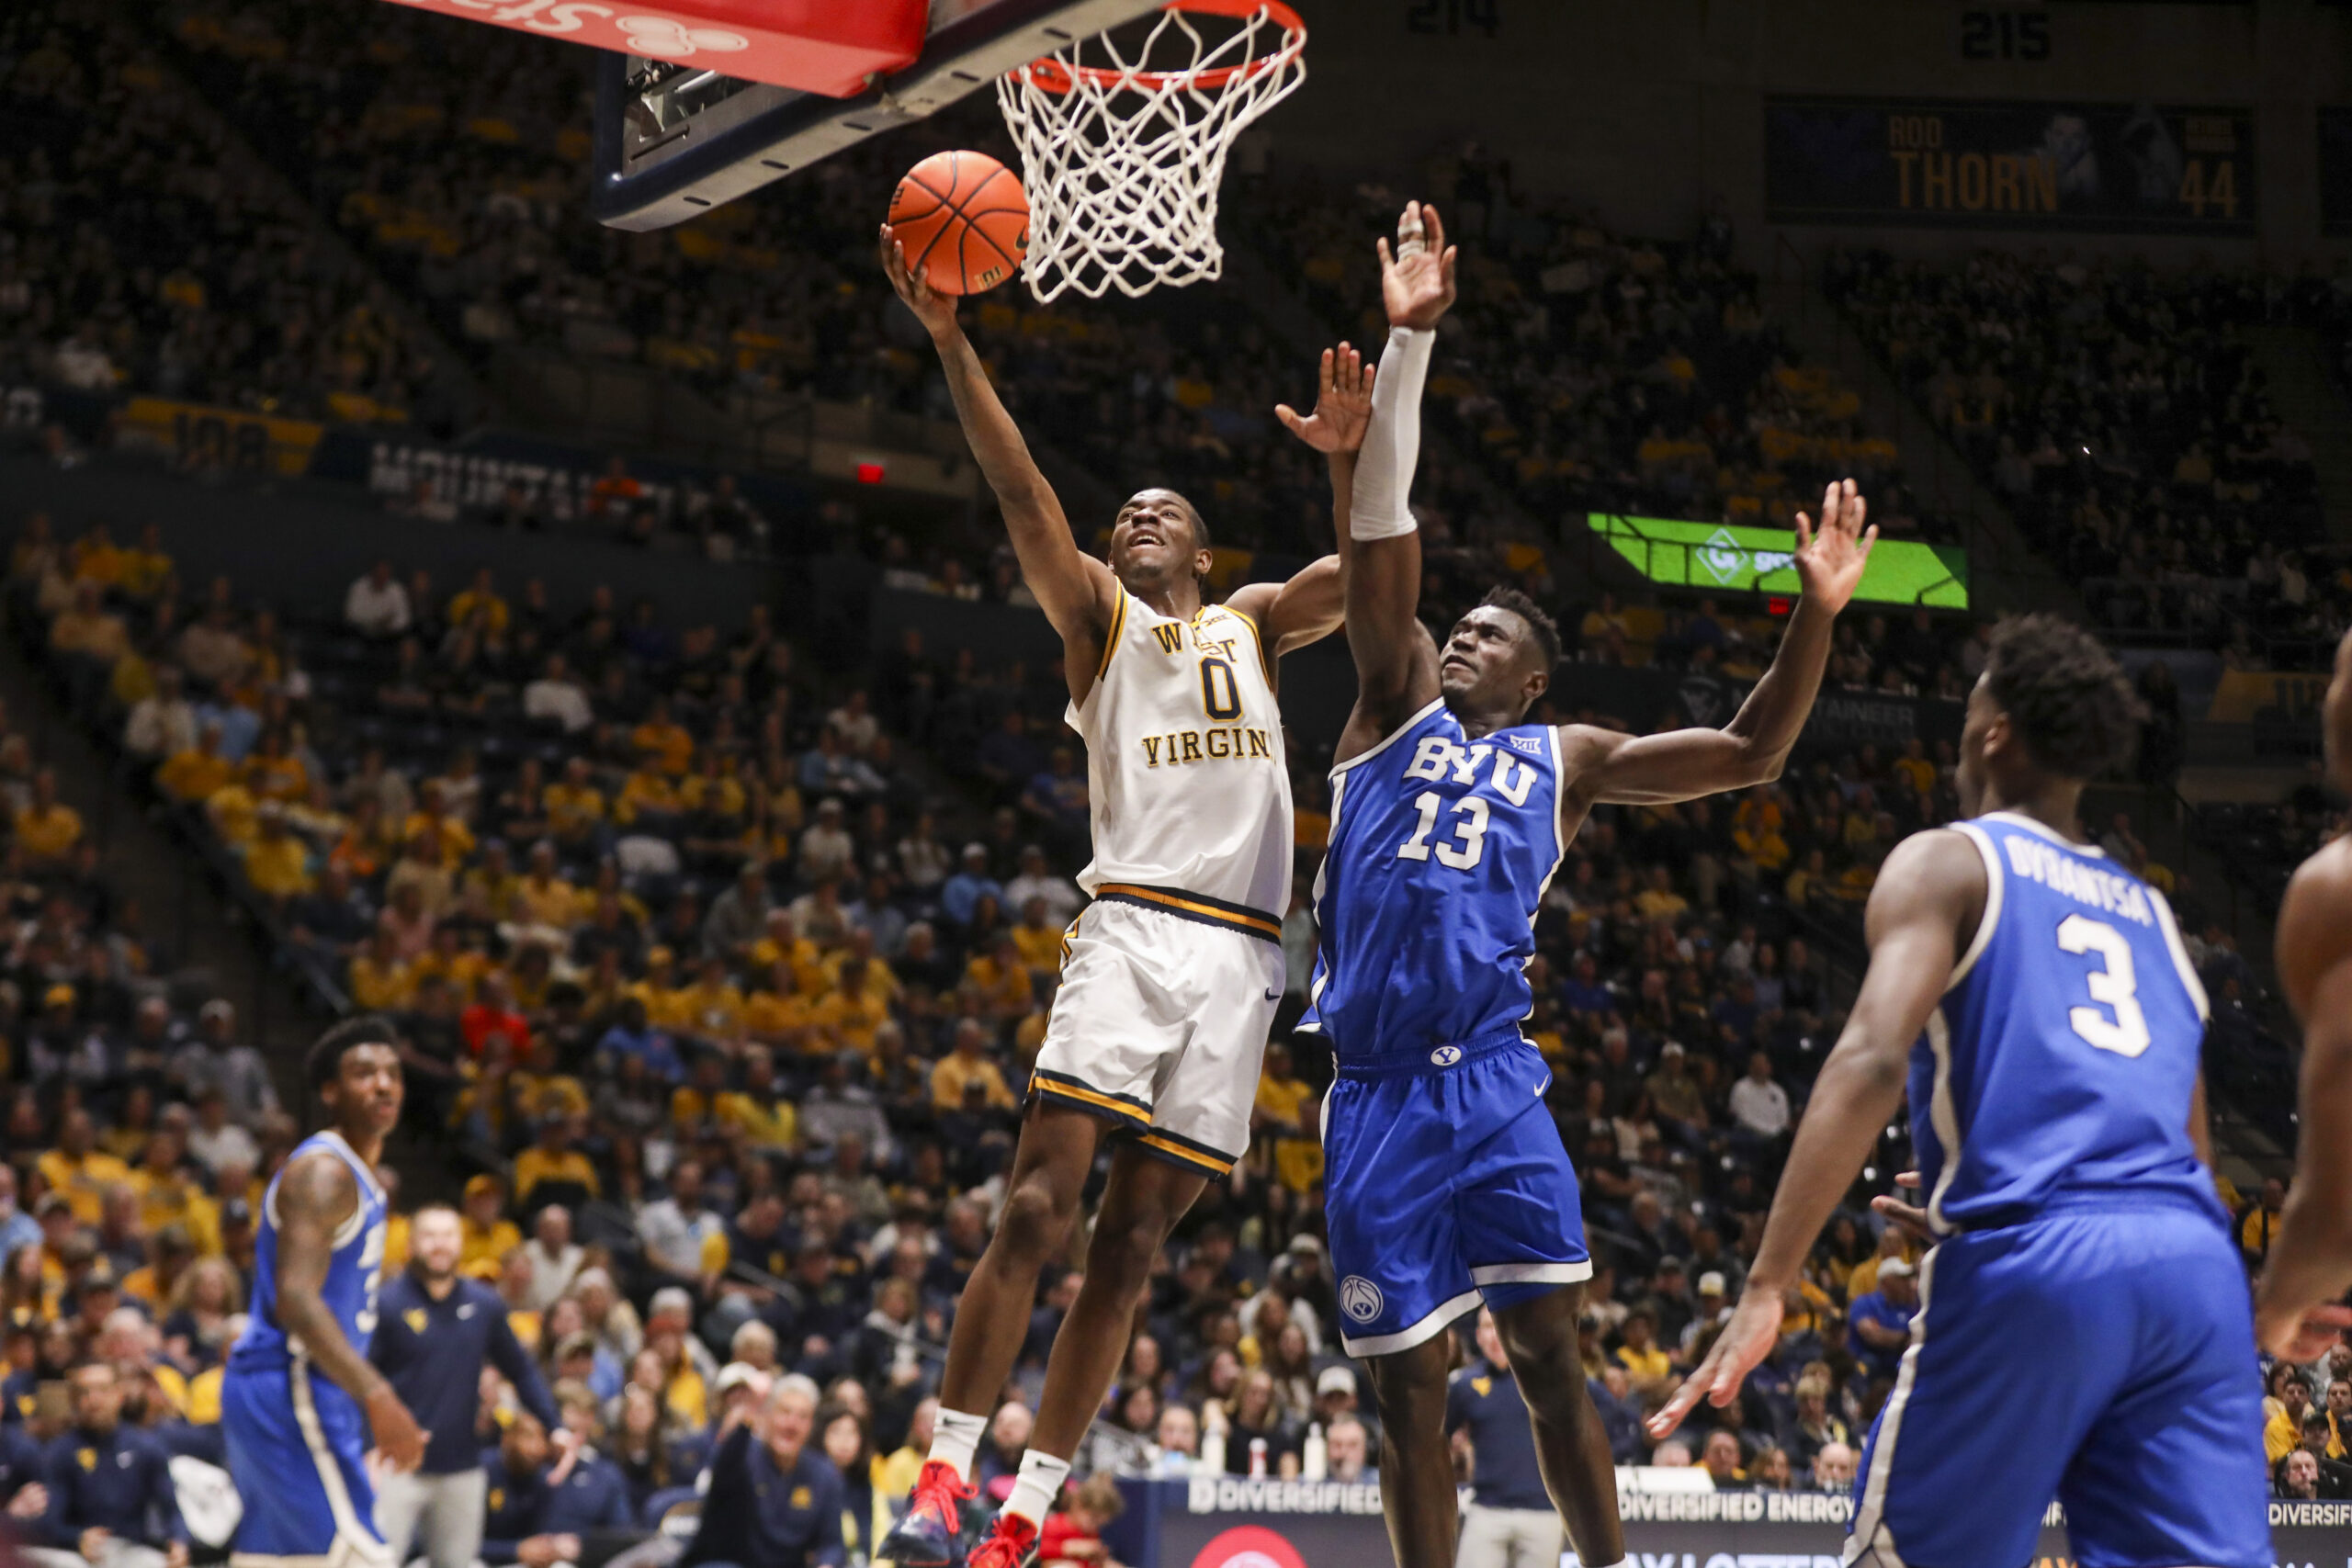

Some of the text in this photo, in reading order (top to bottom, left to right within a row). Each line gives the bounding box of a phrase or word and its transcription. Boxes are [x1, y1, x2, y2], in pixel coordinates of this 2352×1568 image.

[1962, 11, 2050, 61] 215
[1889, 115, 1943, 149] ROD
[1889, 150, 2059, 212] THORN
[2178, 159, 2240, 219] 44
[1152, 621, 1238, 662] WST
[1198, 654, 1244, 723] 0
[1141, 728, 1276, 768] VIRGIN
[1402, 736, 1539, 807] BYU
[1396, 791, 1490, 871] 13
[2056, 913, 2152, 1058] 3
[1217, 1480, 1383, 1515] DIVERSIFIED
[1618, 1492, 1856, 1524] DIVERSIFIED ENERGY
[2267, 1502, 2352, 1527] DIVERSIF
